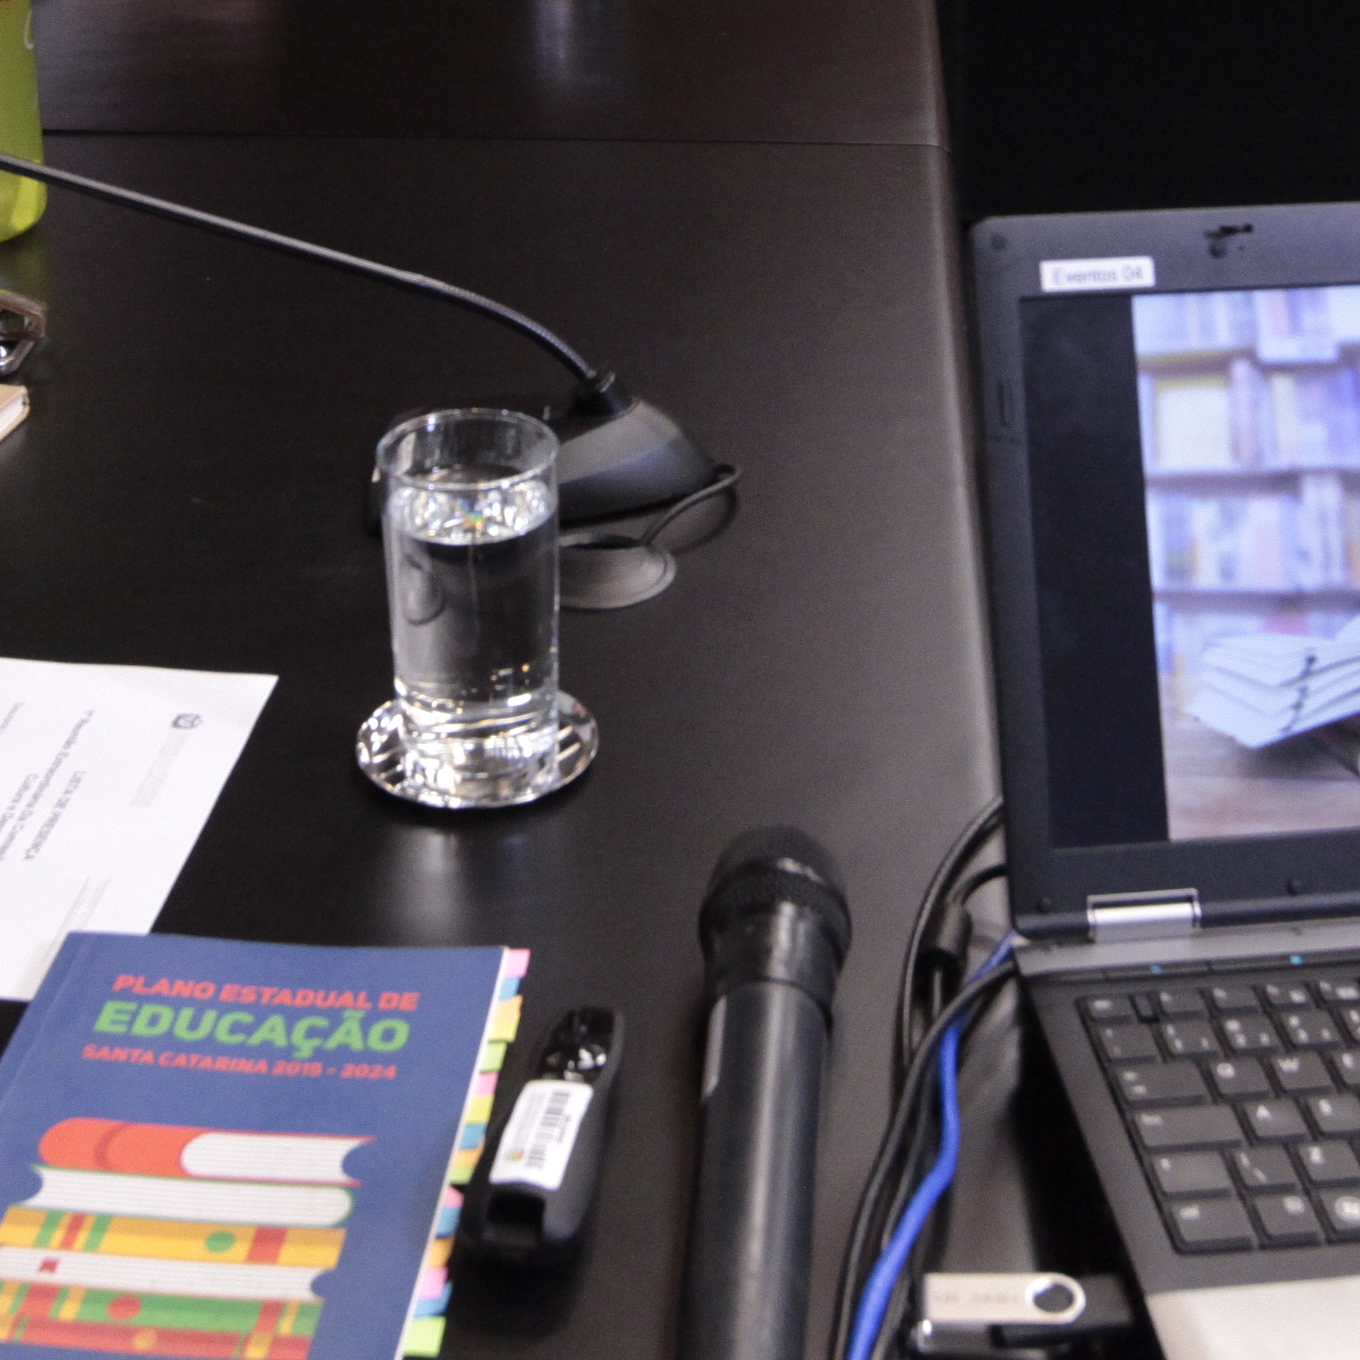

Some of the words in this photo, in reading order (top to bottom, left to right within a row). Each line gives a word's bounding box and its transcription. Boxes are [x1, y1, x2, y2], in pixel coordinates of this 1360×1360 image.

[112, 974, 217, 1000] PLANO
[219, 983, 373, 1010] ESTADUAL
[378, 991, 421, 1011] DE
[93, 999, 410, 1059] EDUCAÇÃO
[82, 1044, 155, 1064] SANTA
[158, 1051, 268, 1074] CATARINA
[272, 1059, 324, 1077] 2015
[339, 1062, 398, 1080] 2024
